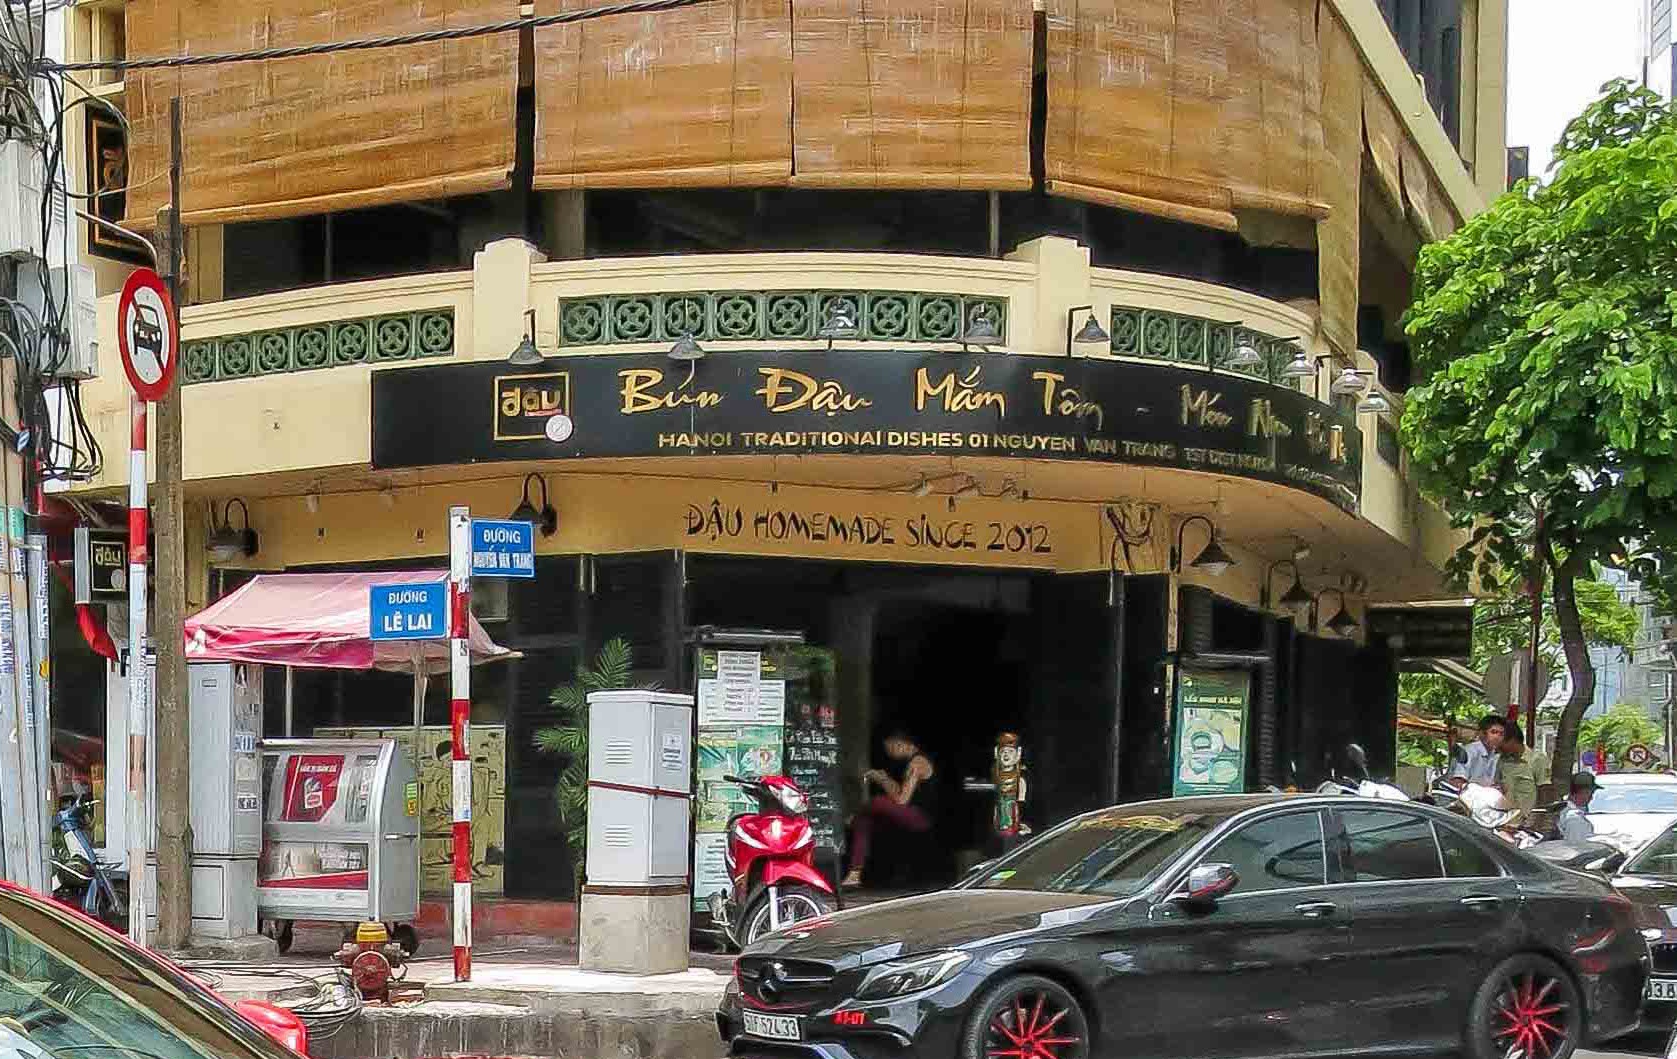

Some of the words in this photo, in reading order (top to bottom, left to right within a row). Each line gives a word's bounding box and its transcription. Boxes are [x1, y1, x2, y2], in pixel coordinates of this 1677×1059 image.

[617, 368, 723, 414] Bún
[755, 367, 873, 416] Đậu
[914, 366, 1006, 417] Mắm
[658, 431, 732, 448] HANOI
[887, 431, 962, 448] DISHES
[969, 433, 989, 448] 01
[993, 434, 1076, 451] NGUYEN
[1085, 438, 1117, 454] VAN
[683, 499, 744, 542] ĐẬU
[753, 511, 896, 546] HOMEMADE
[987, 521, 1053, 553] 2012
[384, 611, 404, 632] LÊ
[407, 613, 432, 631] LAI
